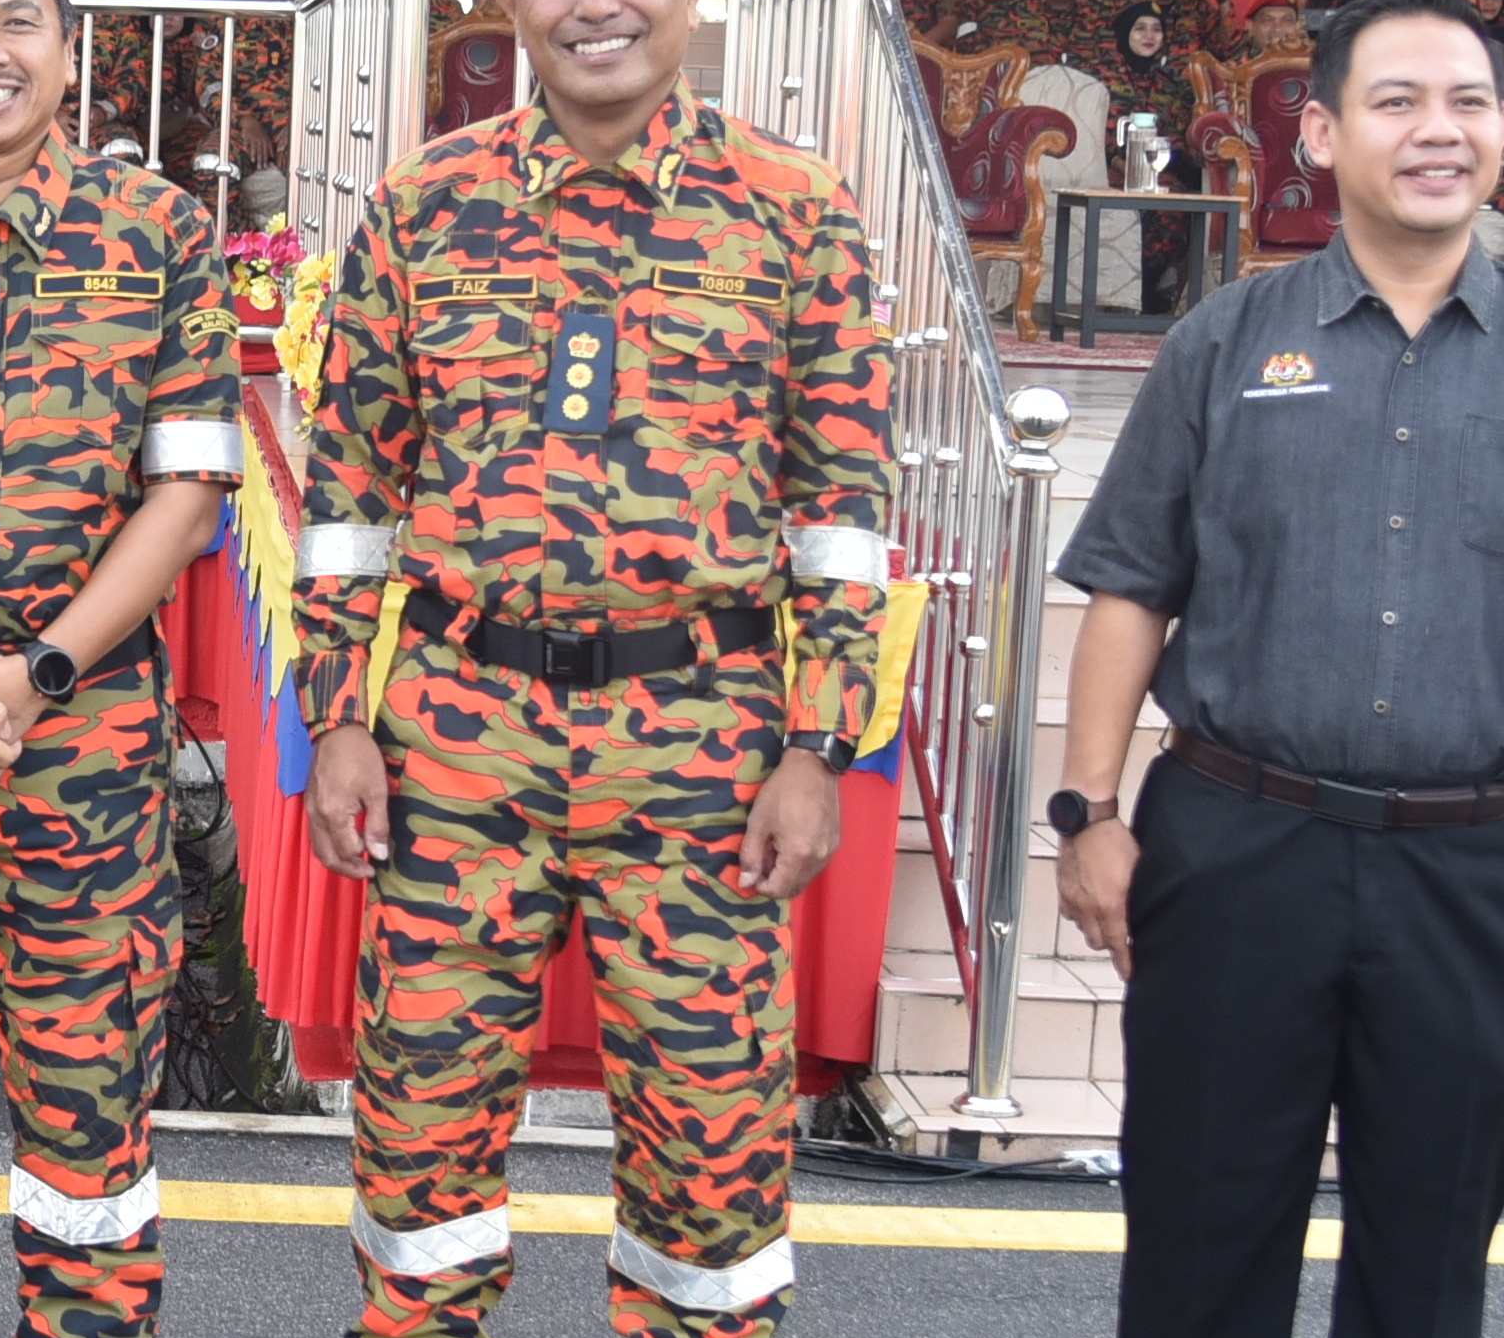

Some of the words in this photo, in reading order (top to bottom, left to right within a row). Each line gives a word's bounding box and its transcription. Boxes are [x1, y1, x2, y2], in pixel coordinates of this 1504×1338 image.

[84, 278, 117, 291] 8542
[452, 280, 490, 295] FAIZ
[697, 275, 745, 293] 10809
